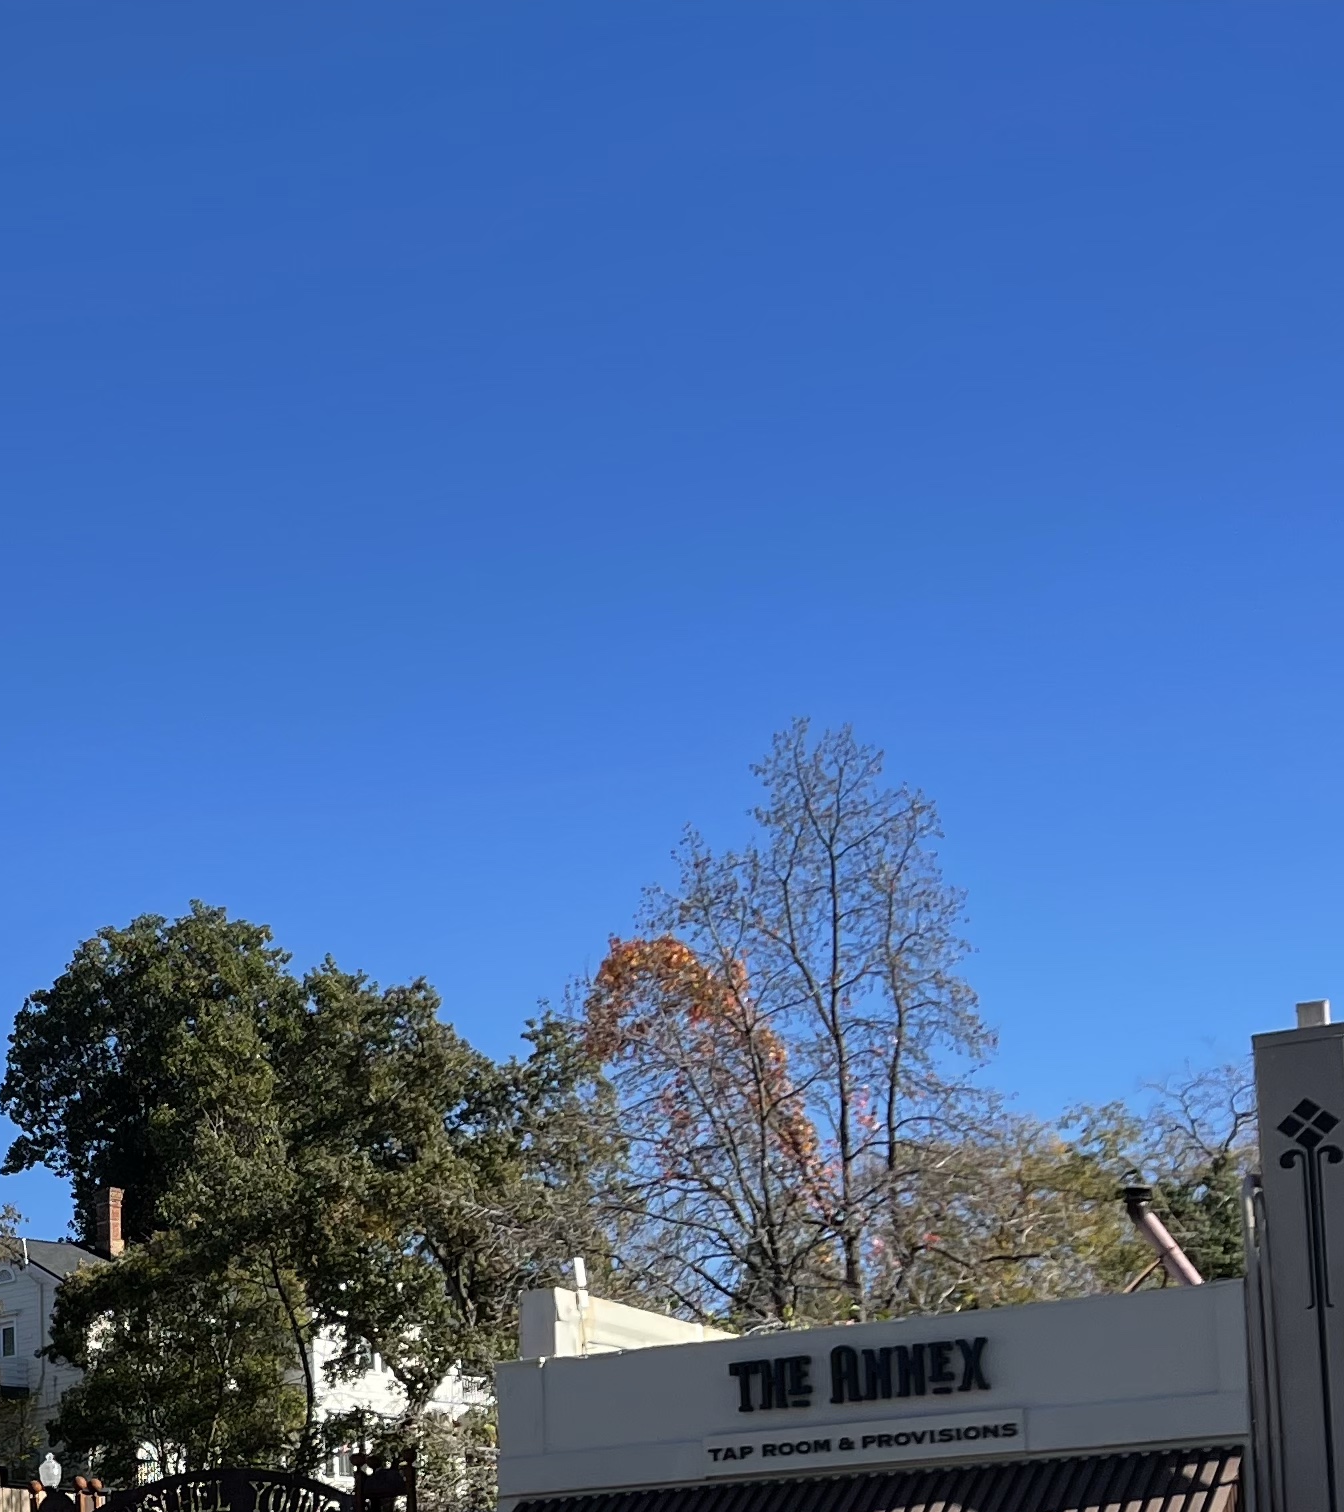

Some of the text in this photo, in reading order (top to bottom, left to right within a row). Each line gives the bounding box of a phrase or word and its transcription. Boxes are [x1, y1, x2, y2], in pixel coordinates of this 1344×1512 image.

[728, 1355, 812, 1412] THE
[708, 1422, 1018, 1462] TAP ROOM & PROVISIONS
